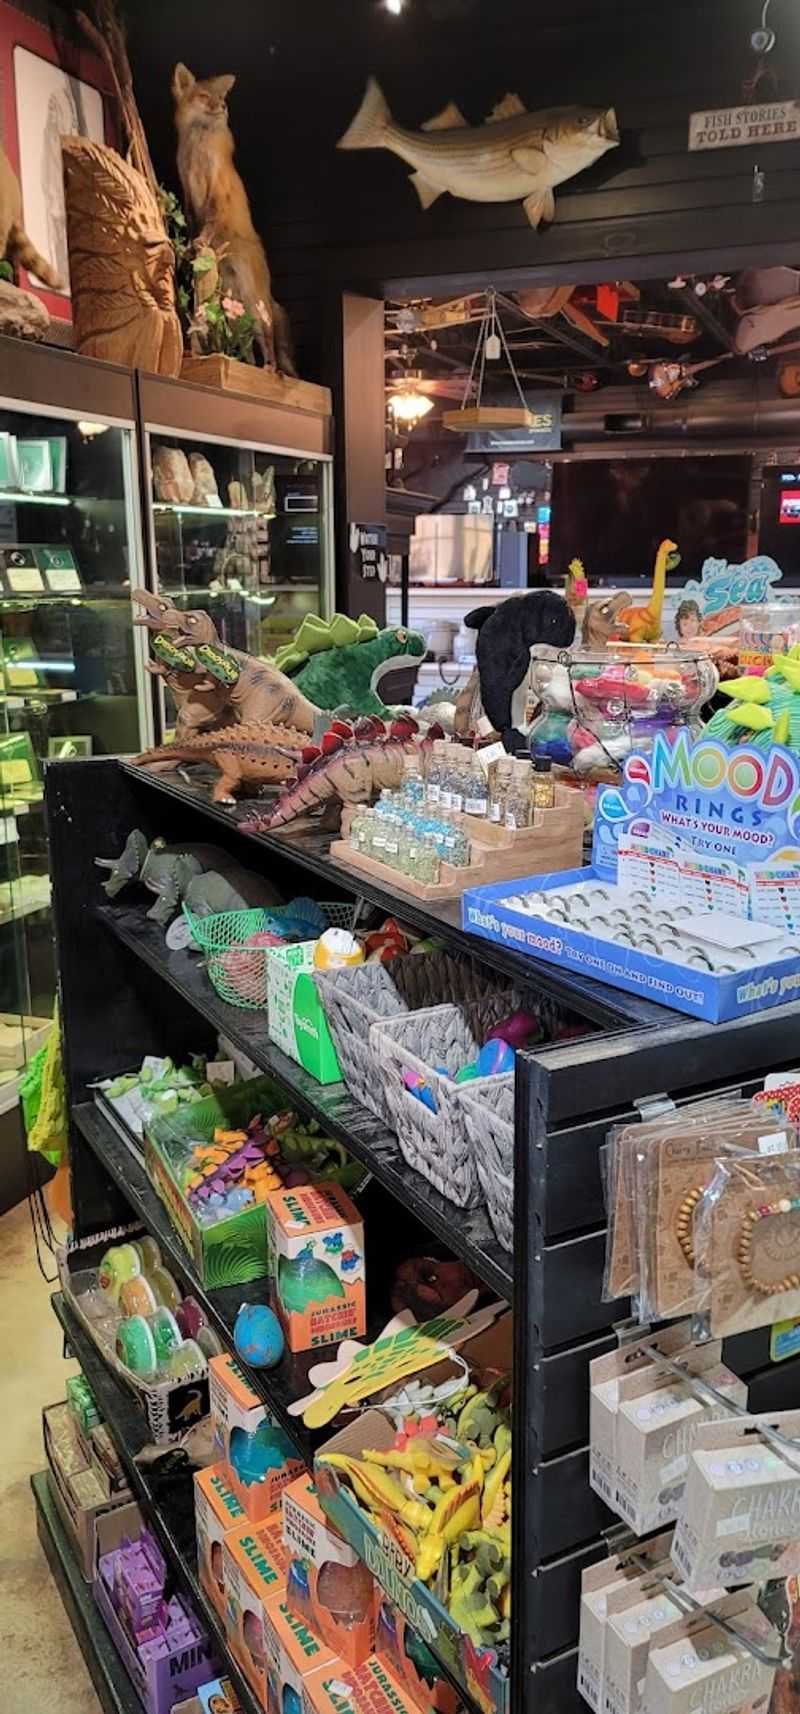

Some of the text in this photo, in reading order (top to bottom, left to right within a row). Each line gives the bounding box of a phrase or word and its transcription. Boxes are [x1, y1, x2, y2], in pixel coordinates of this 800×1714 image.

[696, 121, 797, 143] TOLD HERE
[704, 107, 785, 129] FISH STORIES
[704, 575, 769, 615] Sea
[653, 733, 795, 807] MOOD
[662, 811, 774, 844] WHAT'S YOUR MOOD?
[676, 795, 763, 827] RINGS
[691, 835, 737, 856] TRY ONE
[648, 976, 674, 993] FIND
[311, 1326, 357, 1345] SLIME
[210, 1476, 245, 1519] SLIME
[731, 1487, 800, 1521] CHAKR
[239, 1535, 279, 1585] SLIME
[279, 1602, 321, 1657] SLIME
[169, 1643, 211, 1678] MIN
